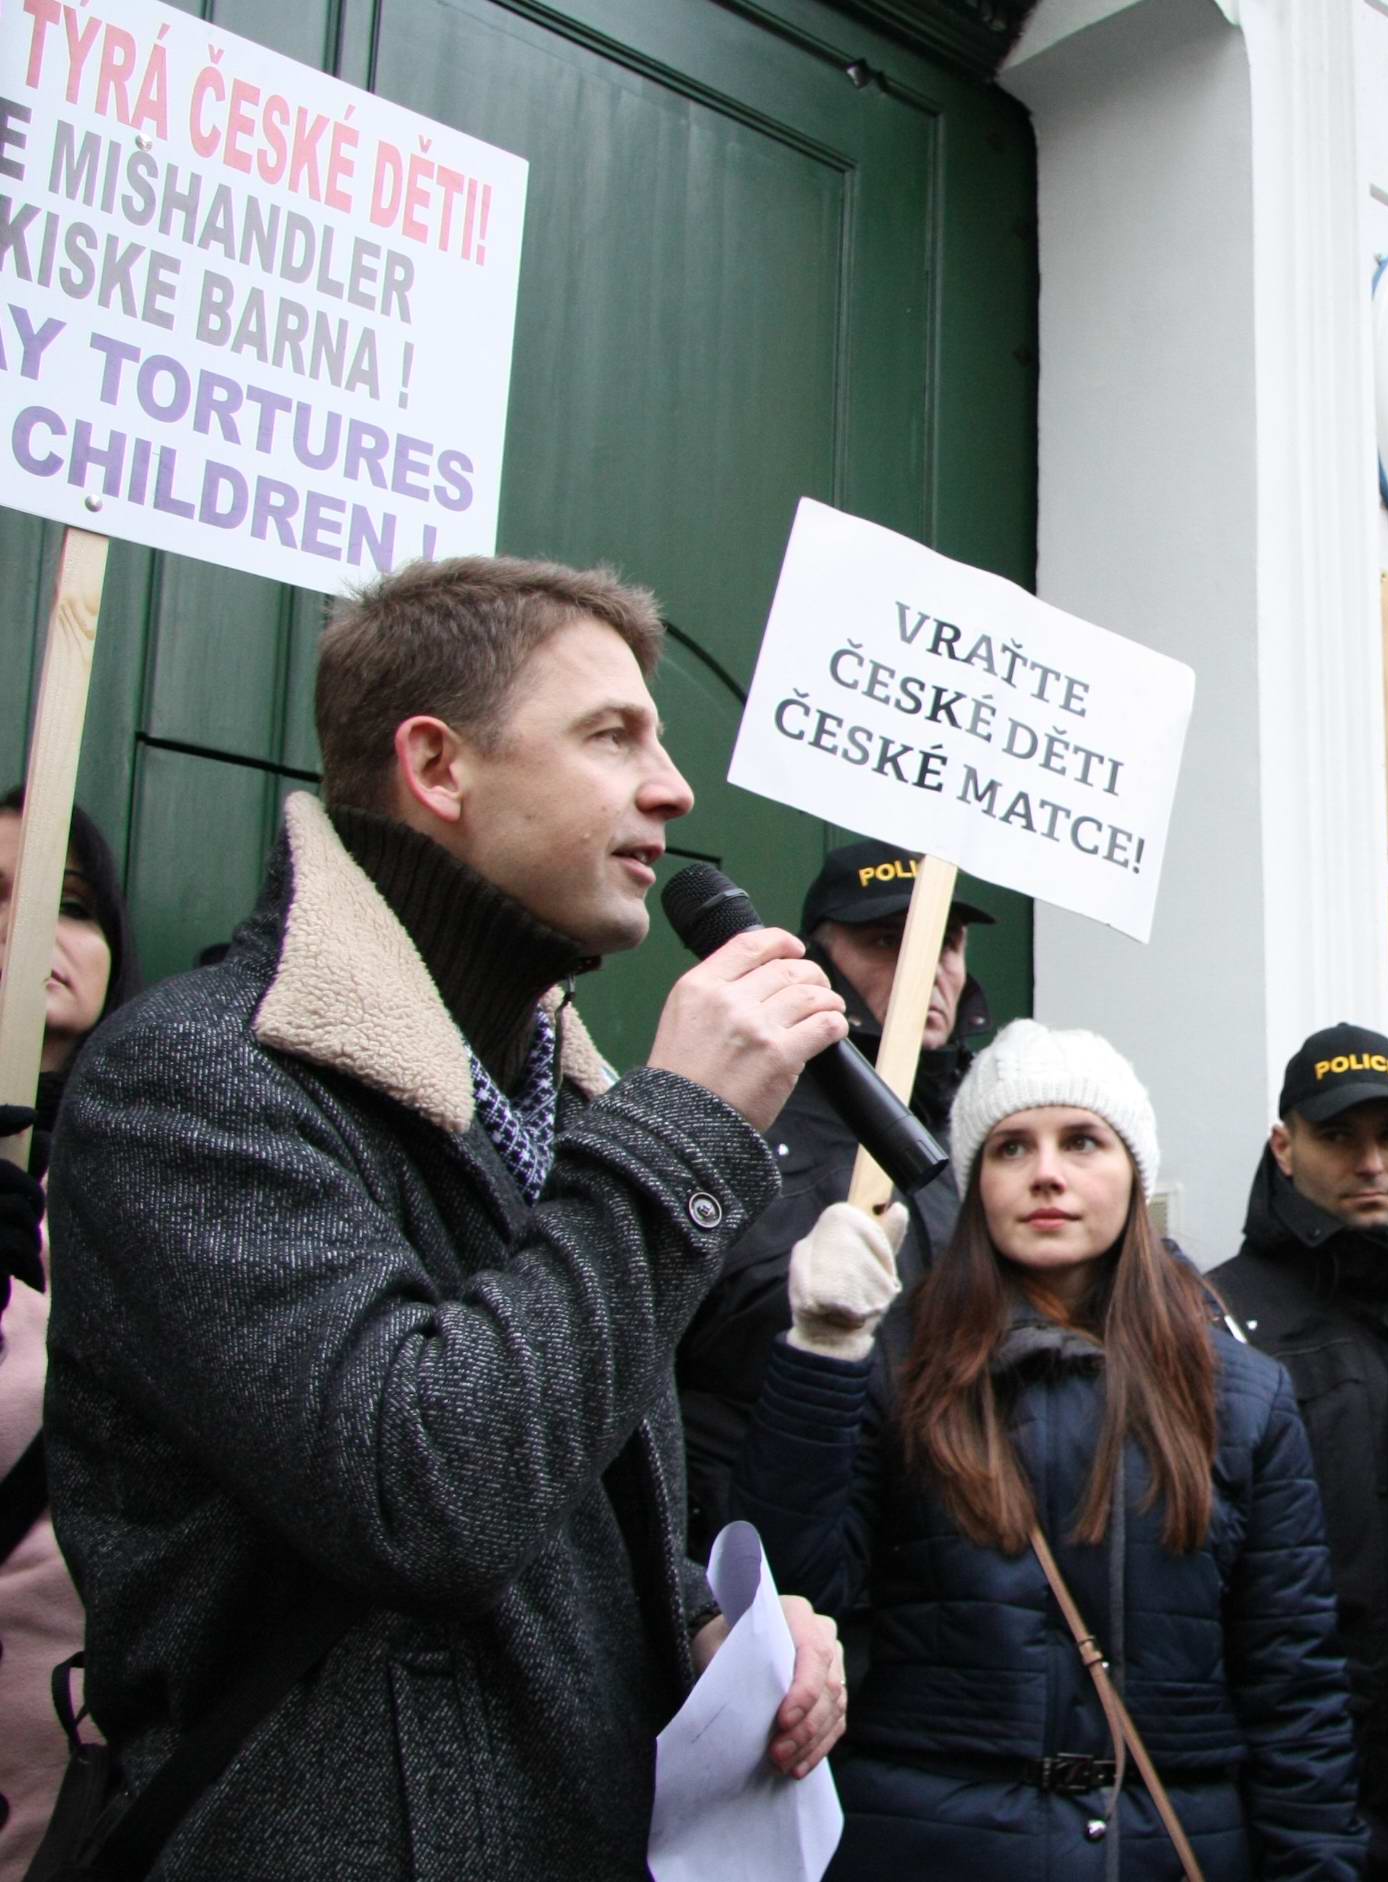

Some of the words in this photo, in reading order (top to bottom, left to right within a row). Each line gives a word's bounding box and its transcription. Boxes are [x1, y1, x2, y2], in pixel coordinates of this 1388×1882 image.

[189, 44, 361, 214] ČESKÉ
[369, 134, 493, 267] DĚTI!
[0, 303, 67, 381] Y
[89, 331, 475, 512] TORTURES
[196, 269, 381, 401] BARNA
[11, 405, 397, 574] CHILDREN
[828, 637, 998, 743] ČESKÉ
[1002, 716, 1124, 797] DĚTI
[895, 600, 1091, 719] VRAŤTE
[773, 687, 949, 793] ČESKÉ
[956, 763, 1147, 875] MATCE!
[858, 859, 919, 888] POLI
